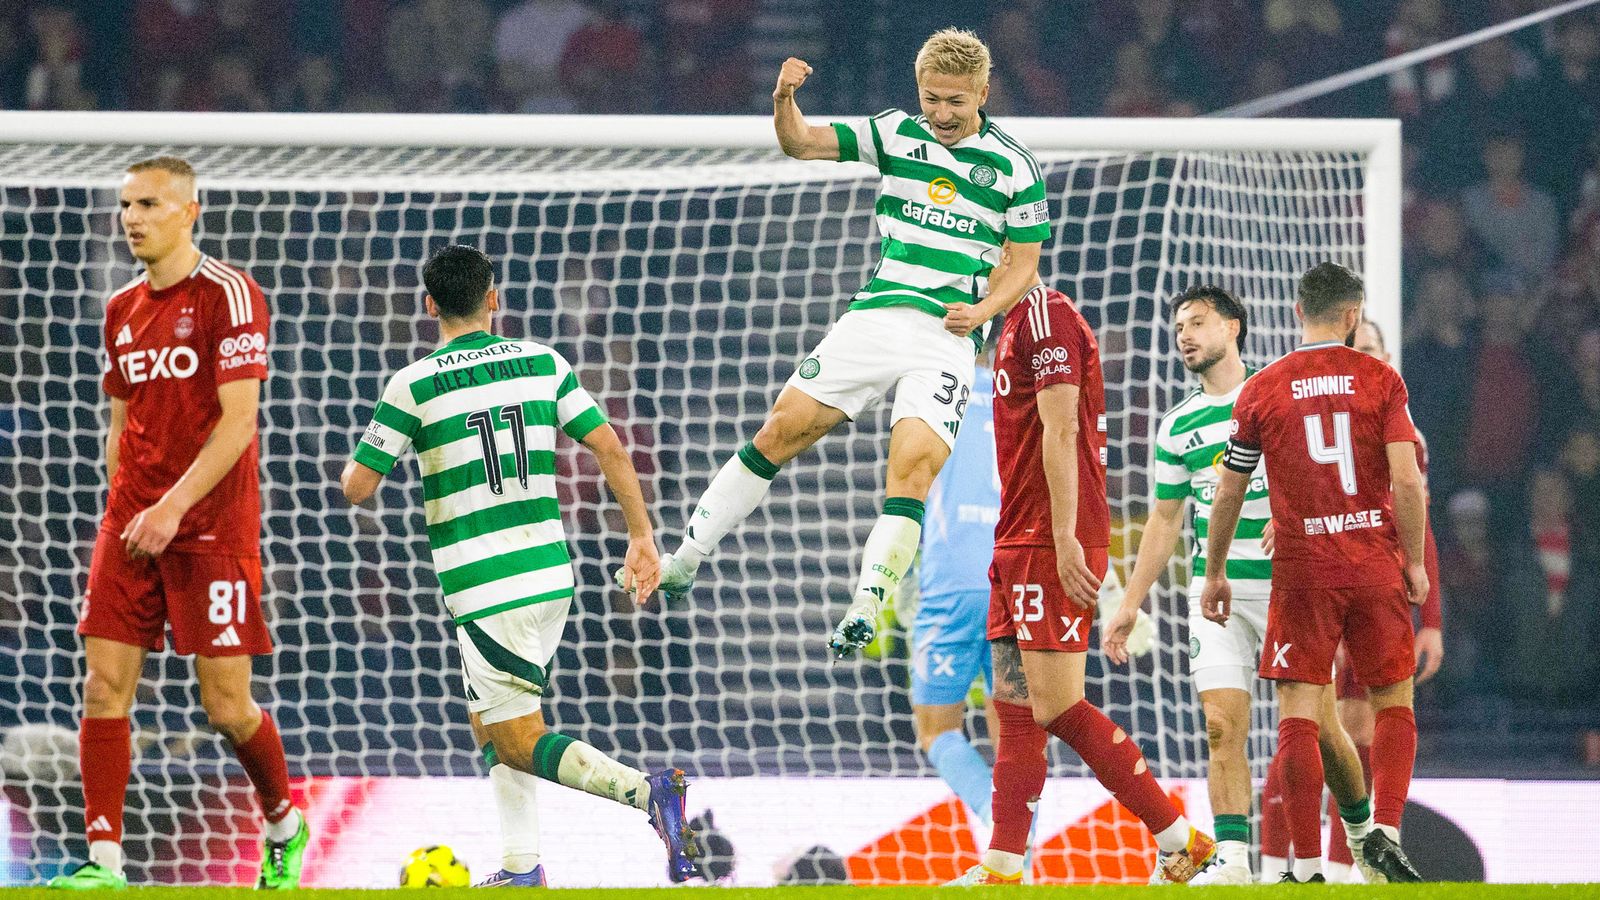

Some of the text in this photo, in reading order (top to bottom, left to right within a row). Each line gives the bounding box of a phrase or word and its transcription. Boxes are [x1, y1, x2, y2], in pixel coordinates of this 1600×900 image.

[902, 200, 977, 234] dafabet
[436, 343, 522, 368] MAGNERS
[433, 357, 539, 396] ÁLEX VALLE
[1291, 375, 1355, 400] SHINNIE
[466, 402, 529, 496] 11
[1303, 411, 1358, 496] 4
[1323, 509, 1382, 534] WASTE
[871, 563, 900, 585] CELTIC
[208, 580, 246, 624] 81
[1012, 584, 1044, 622] 33
